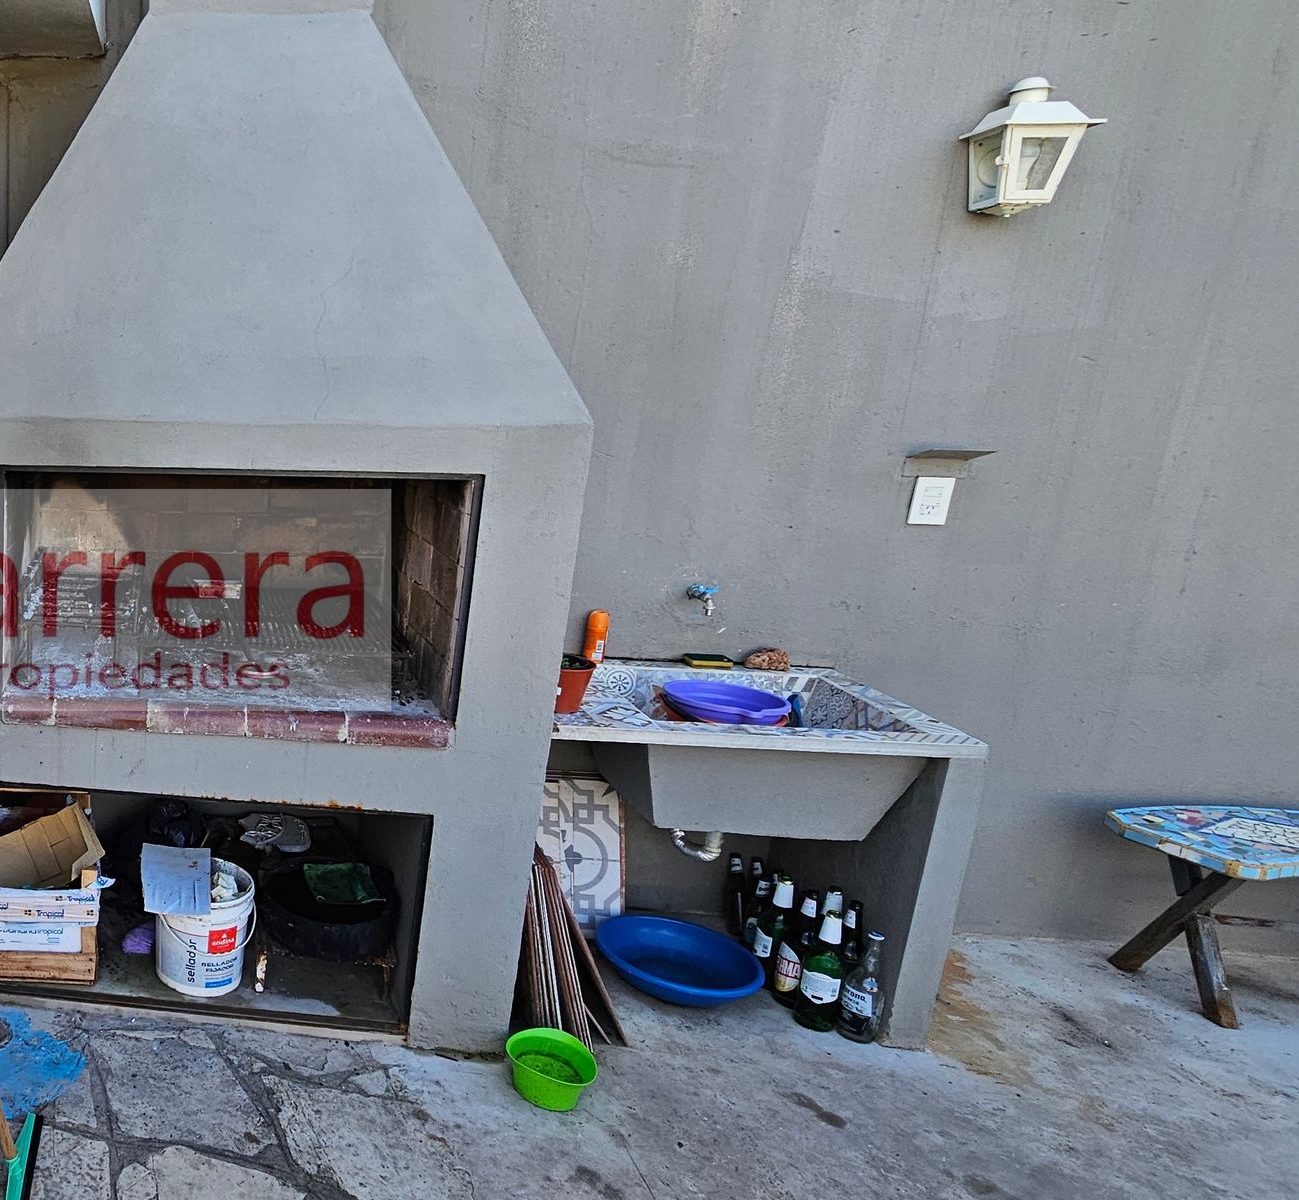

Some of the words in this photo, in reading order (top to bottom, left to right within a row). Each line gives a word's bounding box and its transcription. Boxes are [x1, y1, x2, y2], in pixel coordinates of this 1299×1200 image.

[35, 909, 64, 919] Tropical
[211, 938, 235, 946] andina
[185, 939, 197, 983] sellador
[201, 956, 238, 967] SELLADOR
